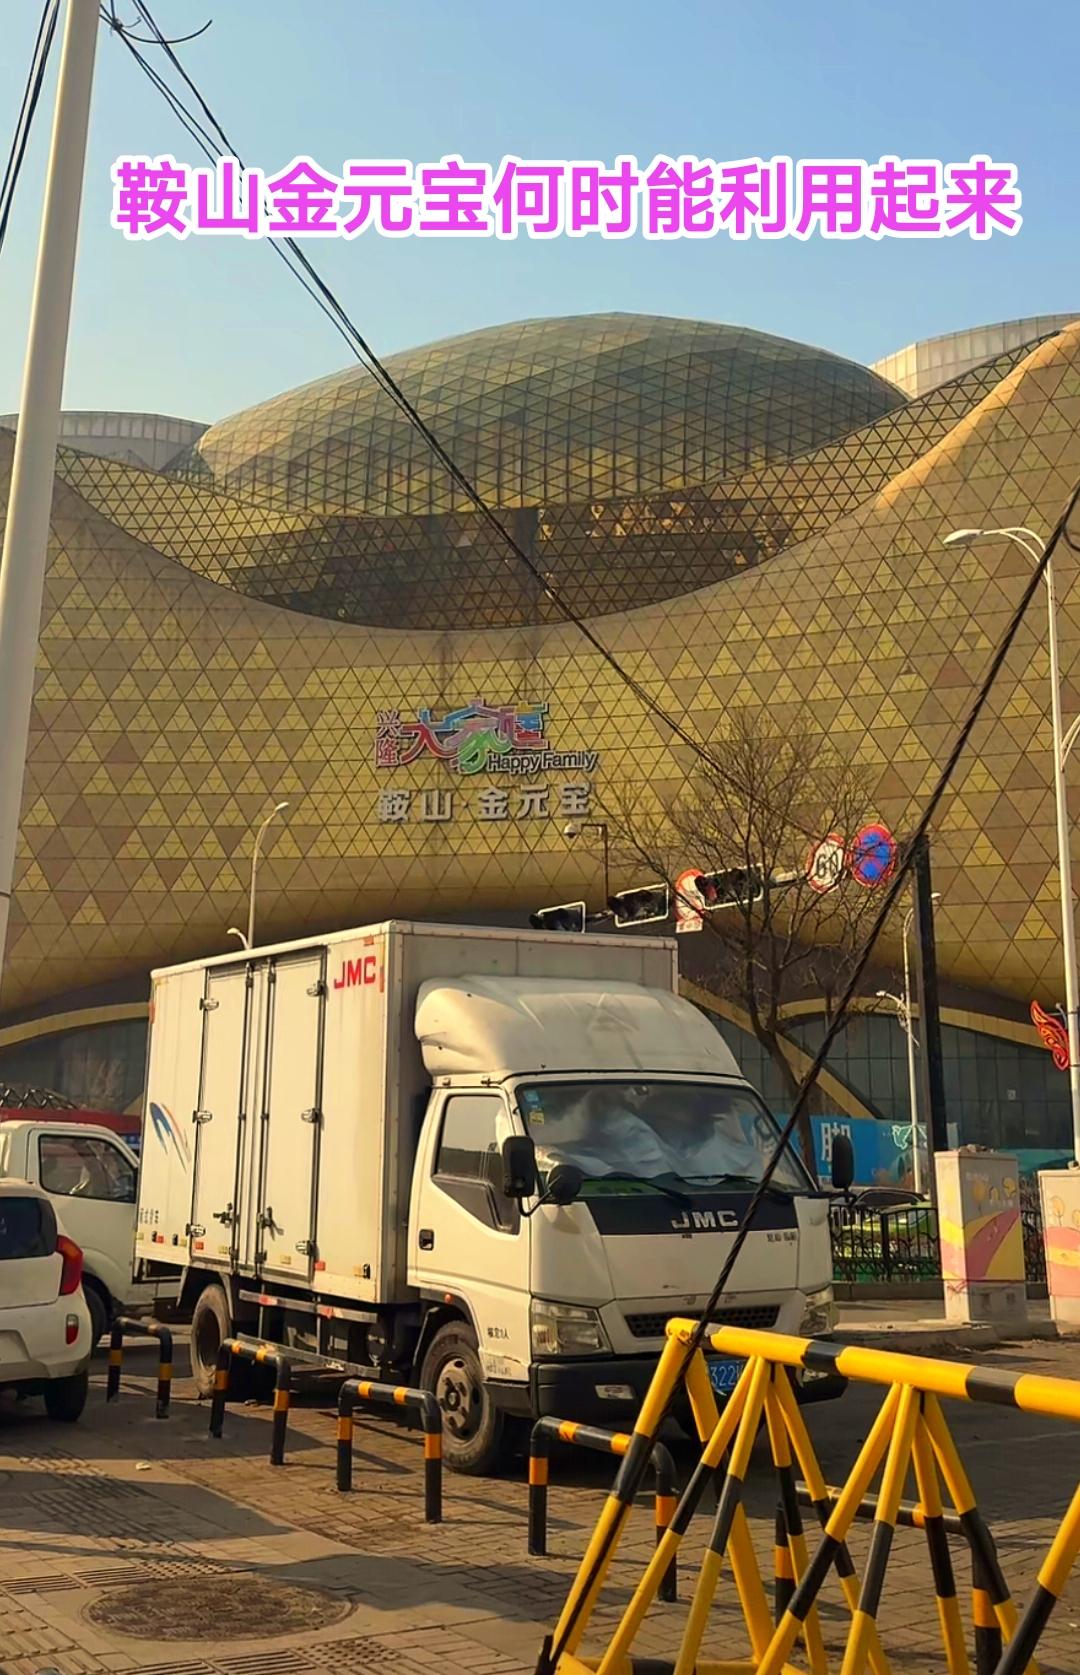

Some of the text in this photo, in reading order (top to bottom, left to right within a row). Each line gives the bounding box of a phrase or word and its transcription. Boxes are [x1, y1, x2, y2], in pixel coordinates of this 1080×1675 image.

[376, 710, 400, 767] 兴隆
[334, 956, 376, 989] JMC
[671, 1210, 739, 1229] JMC
